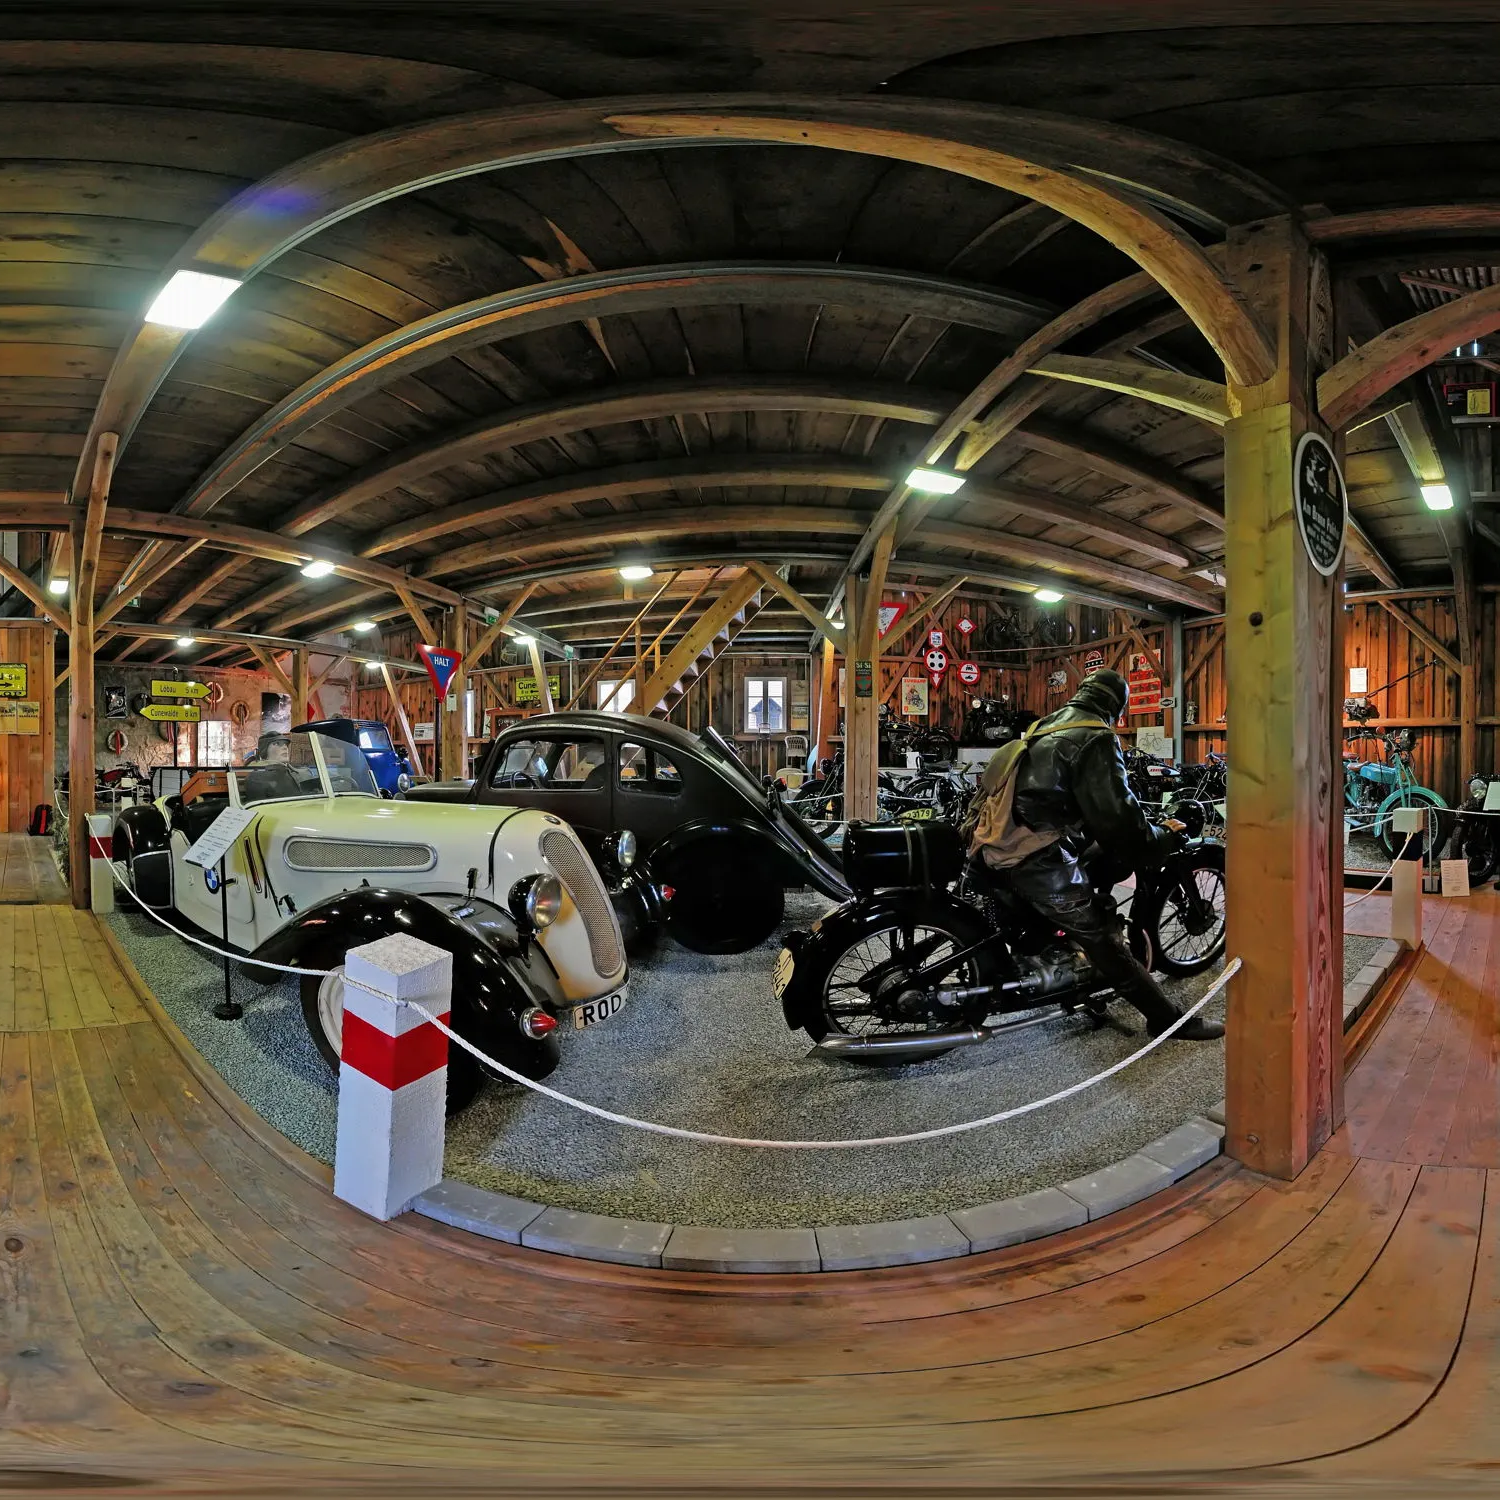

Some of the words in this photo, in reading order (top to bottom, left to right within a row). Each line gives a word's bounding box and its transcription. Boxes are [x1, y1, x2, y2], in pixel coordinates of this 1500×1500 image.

[434, 656, 450, 667] HALT
[150, 708, 179, 718] Cunewalde
[190, 710, 198, 718] km
